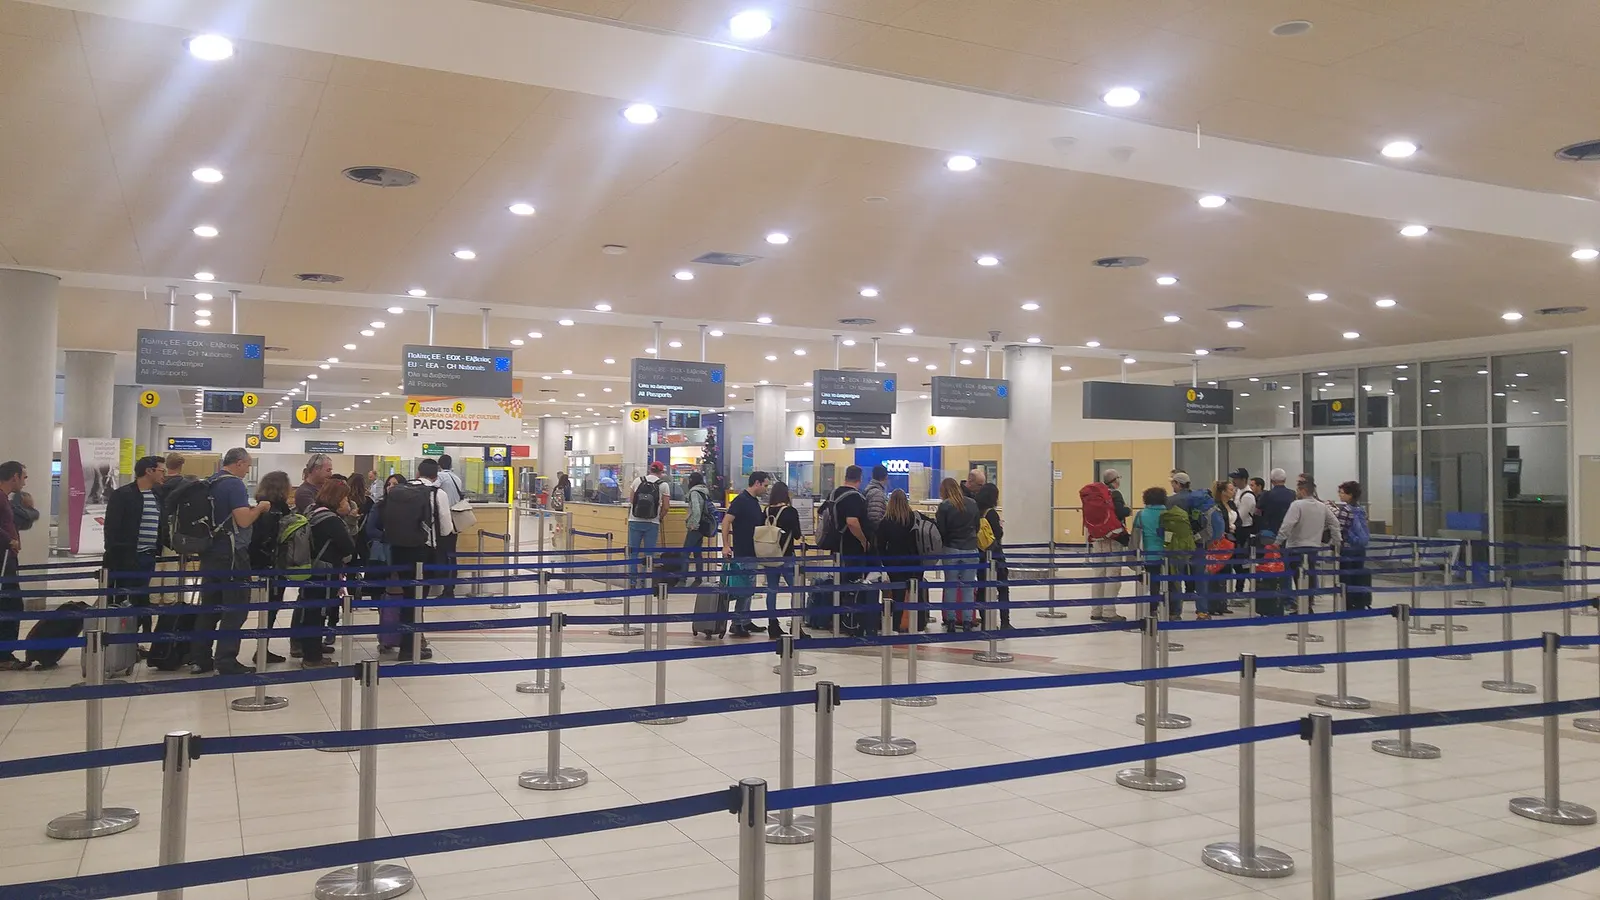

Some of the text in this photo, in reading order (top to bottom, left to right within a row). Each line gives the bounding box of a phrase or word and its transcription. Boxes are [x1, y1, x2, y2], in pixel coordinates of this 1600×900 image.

[146, 393, 154, 404] 9
[247, 396, 253, 404] 8
[410, 403, 417, 412] 7
[456, 403, 462, 412] 6
[302, 408, 308, 421] 1
[634, 411, 640, 420] 5
[413, 419, 479, 430] PAFOS2017
[267, 428, 274, 437] 2
[797, 427, 802, 436] 2
[820, 439, 826, 448] 3
